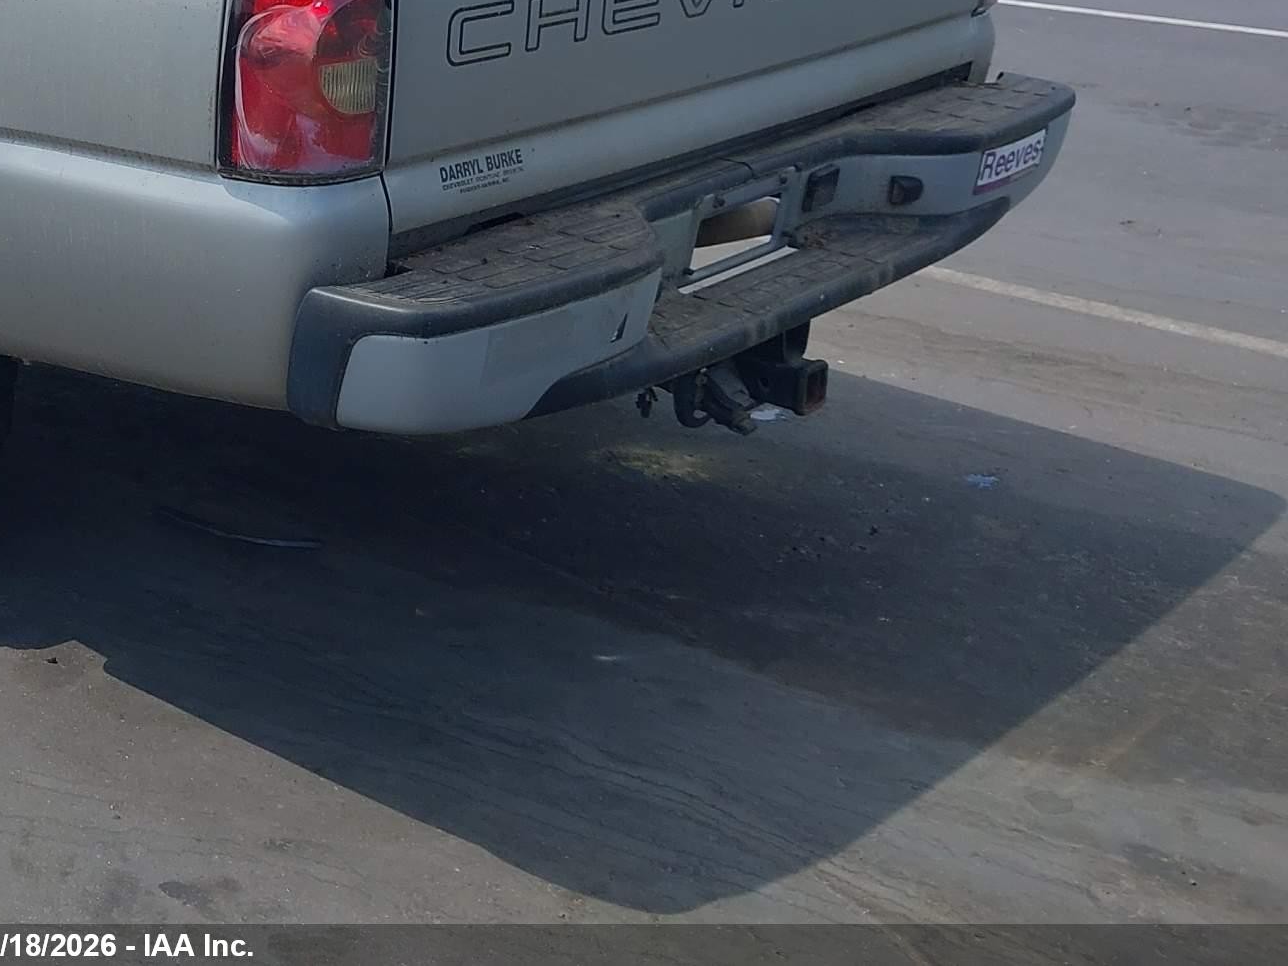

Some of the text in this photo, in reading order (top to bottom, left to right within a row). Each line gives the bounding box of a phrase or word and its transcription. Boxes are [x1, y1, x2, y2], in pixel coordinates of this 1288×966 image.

[439, 158, 484, 183] DARRYL
[485, 148, 524, 172] BURKE
[980, 139, 1043, 181] Reeves
